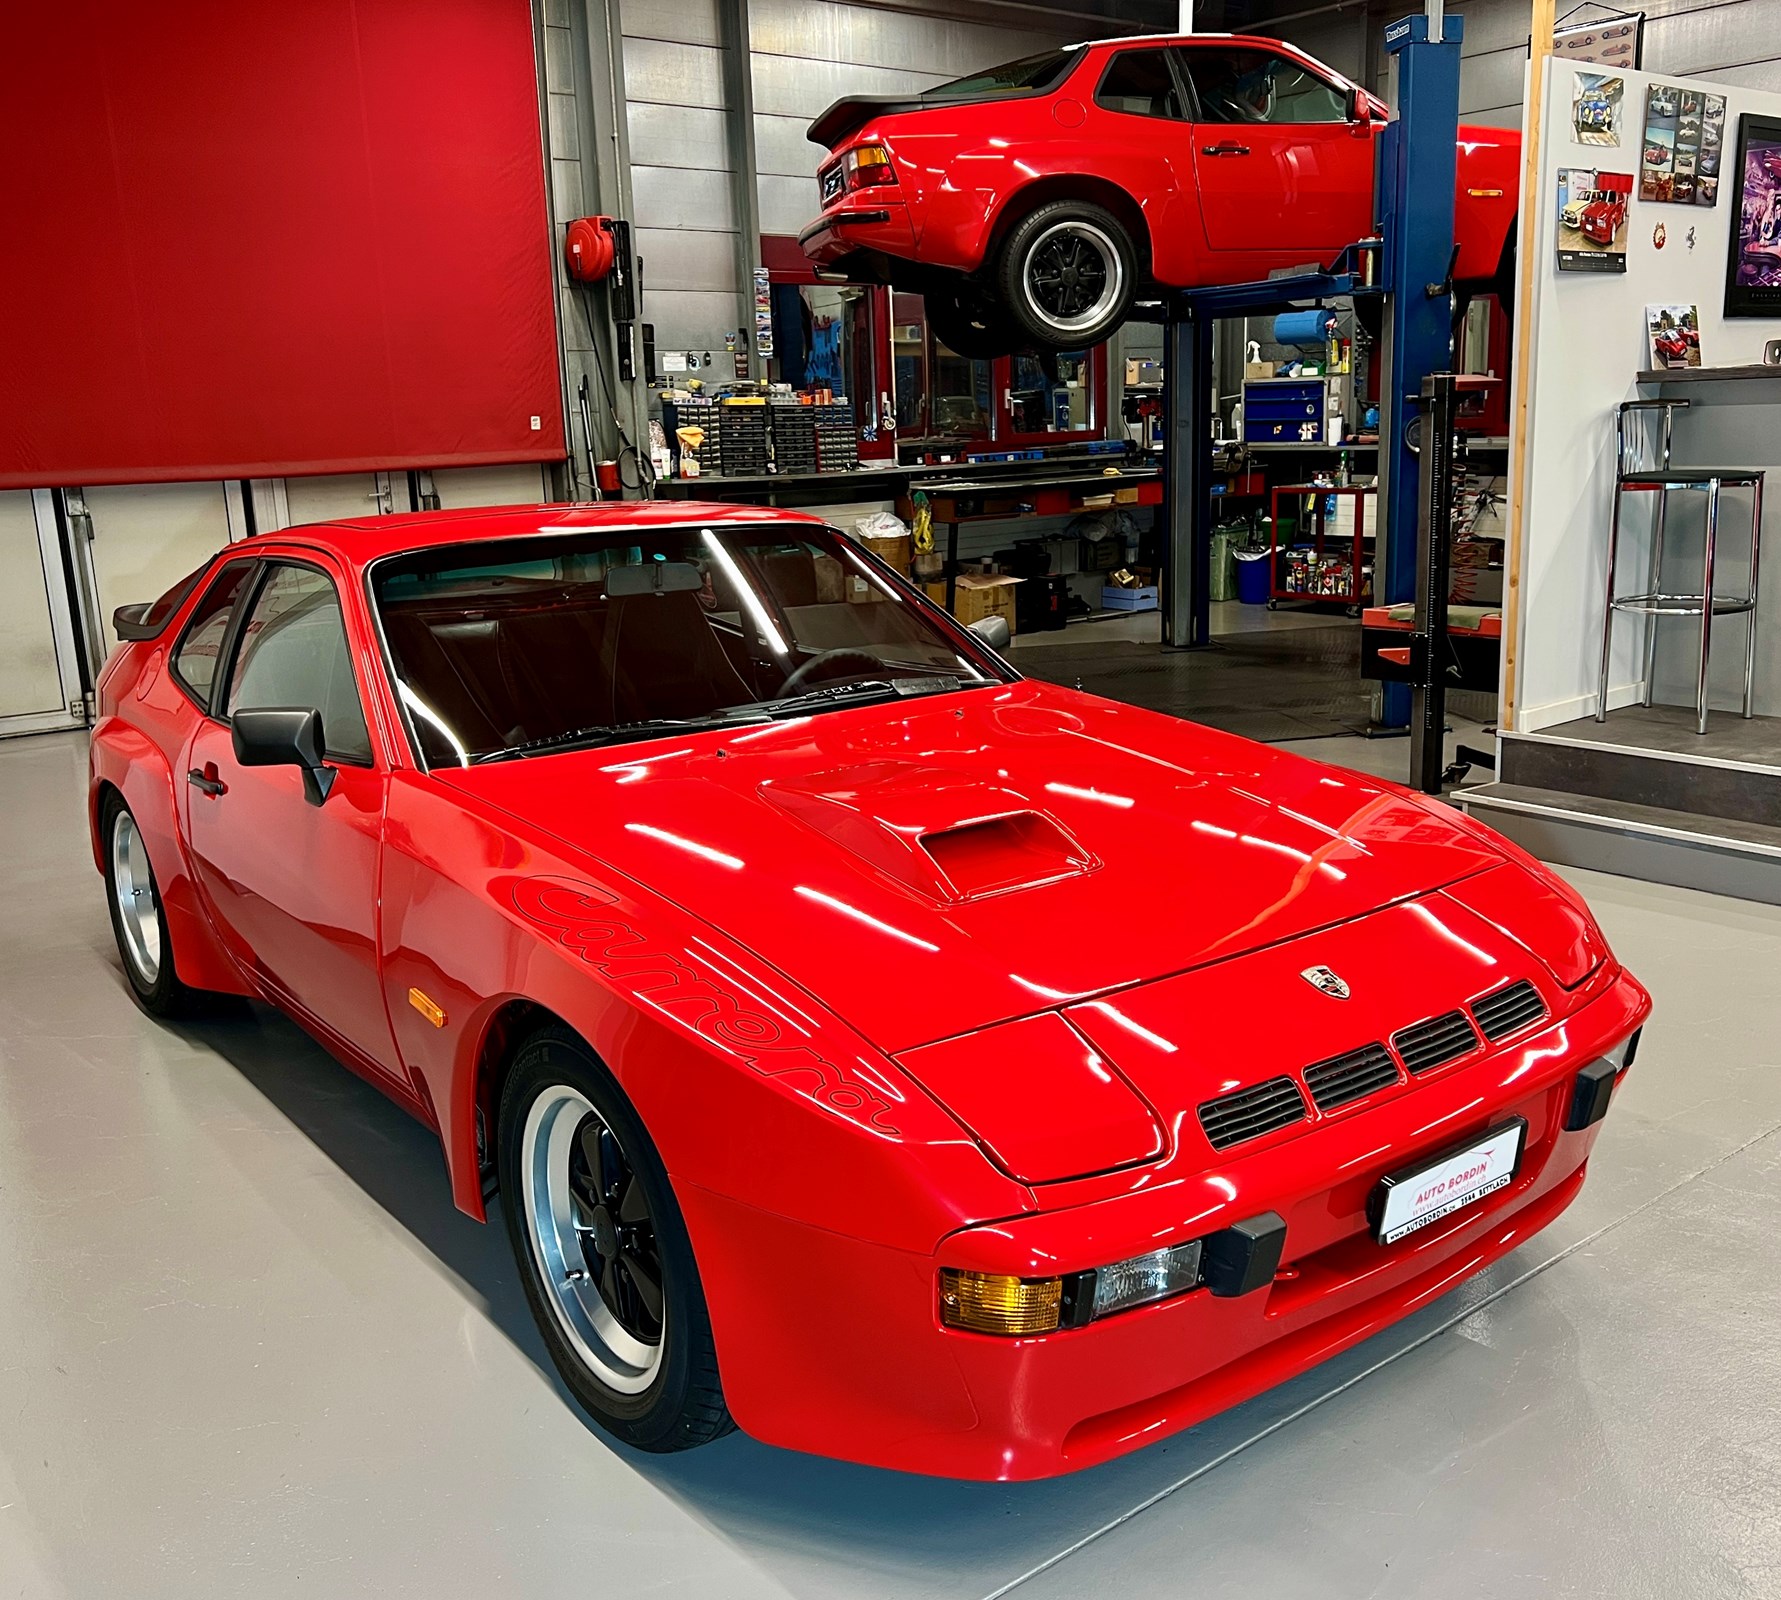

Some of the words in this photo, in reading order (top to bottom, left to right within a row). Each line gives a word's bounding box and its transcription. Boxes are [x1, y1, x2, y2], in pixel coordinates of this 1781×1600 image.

[512, 875, 900, 1134] Carrera
[1412, 1175, 1487, 1216] www.autobordin.ch
[1415, 1182, 1446, 1205] AUTO
[1448, 1162, 1488, 1190] BORDIN
[1479, 1176, 1508, 1196] BETTLACH
